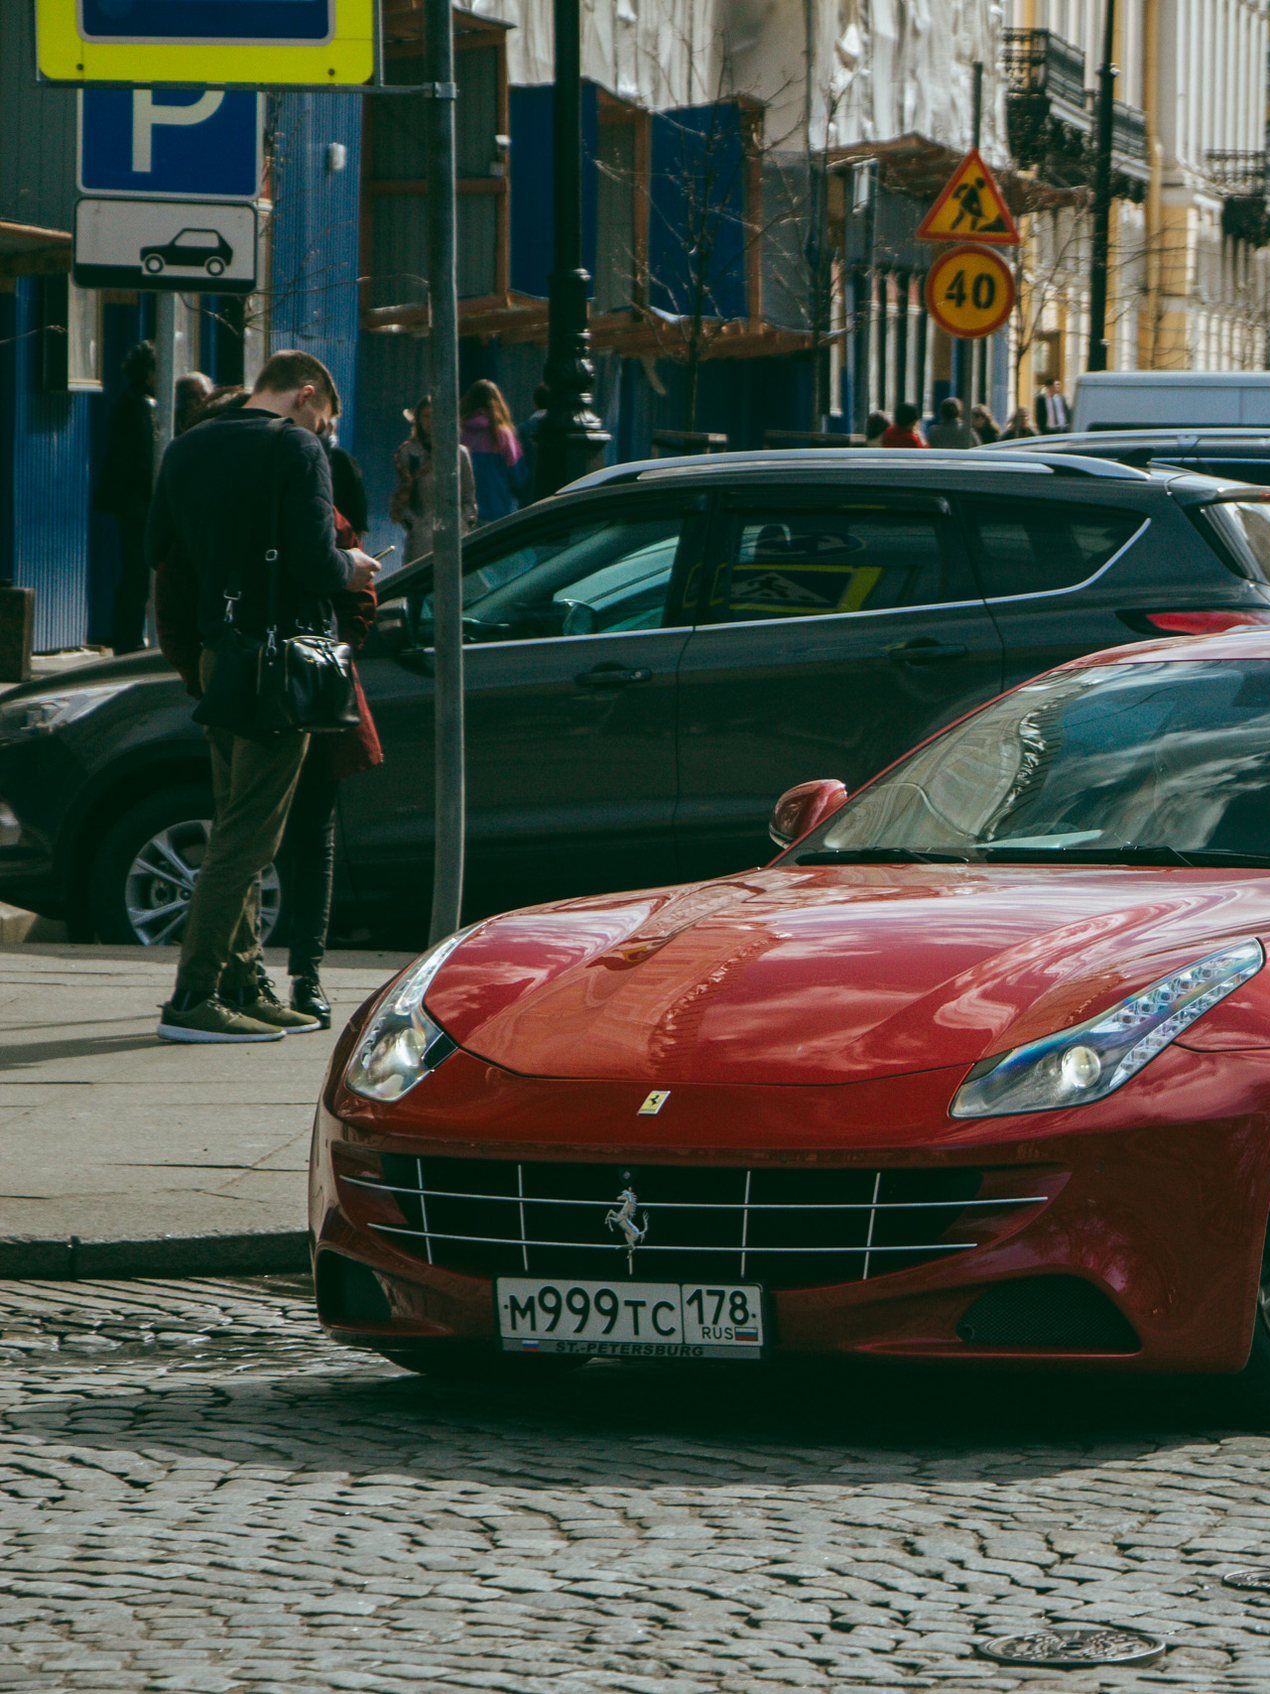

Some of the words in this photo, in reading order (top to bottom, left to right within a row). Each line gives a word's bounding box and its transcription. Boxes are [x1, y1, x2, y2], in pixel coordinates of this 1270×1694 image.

[131, 88, 226, 173] P
[944, 269, 996, 310] 40
[685, 1289, 749, 1326] 178
[555, 1341, 704, 1357] ST.-PETERSBURG
[701, 1326, 734, 1340] RUS
